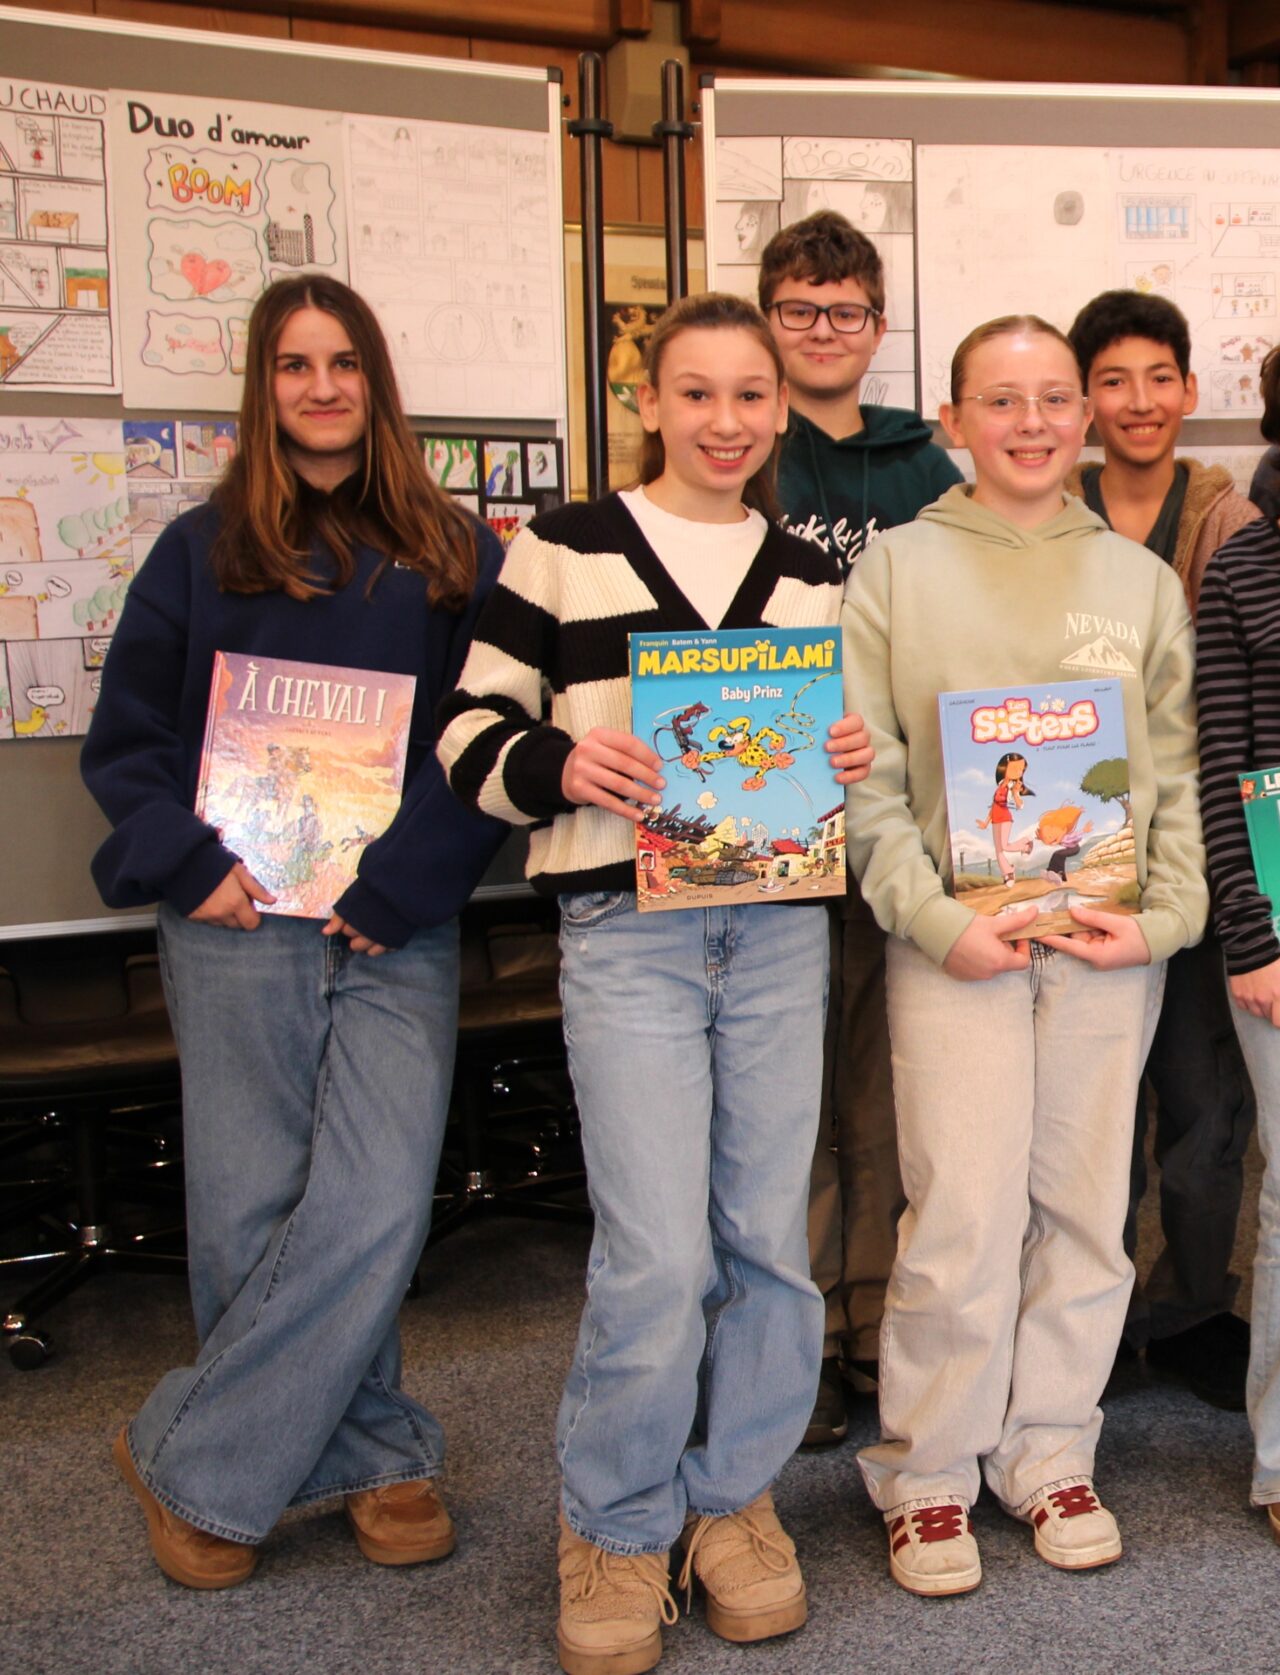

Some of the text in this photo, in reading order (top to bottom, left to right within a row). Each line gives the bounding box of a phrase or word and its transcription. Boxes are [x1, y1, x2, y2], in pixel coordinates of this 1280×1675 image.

[127, 101, 310, 149] Duo d'amour
[168, 163, 252, 207] BOOM
[701, 637, 717, 645] Yann
[1064, 612, 1142, 650] NEVADA
[238, 661, 387, 728] À CHEVAL !
[721, 685, 783, 702] Baby Prinz
